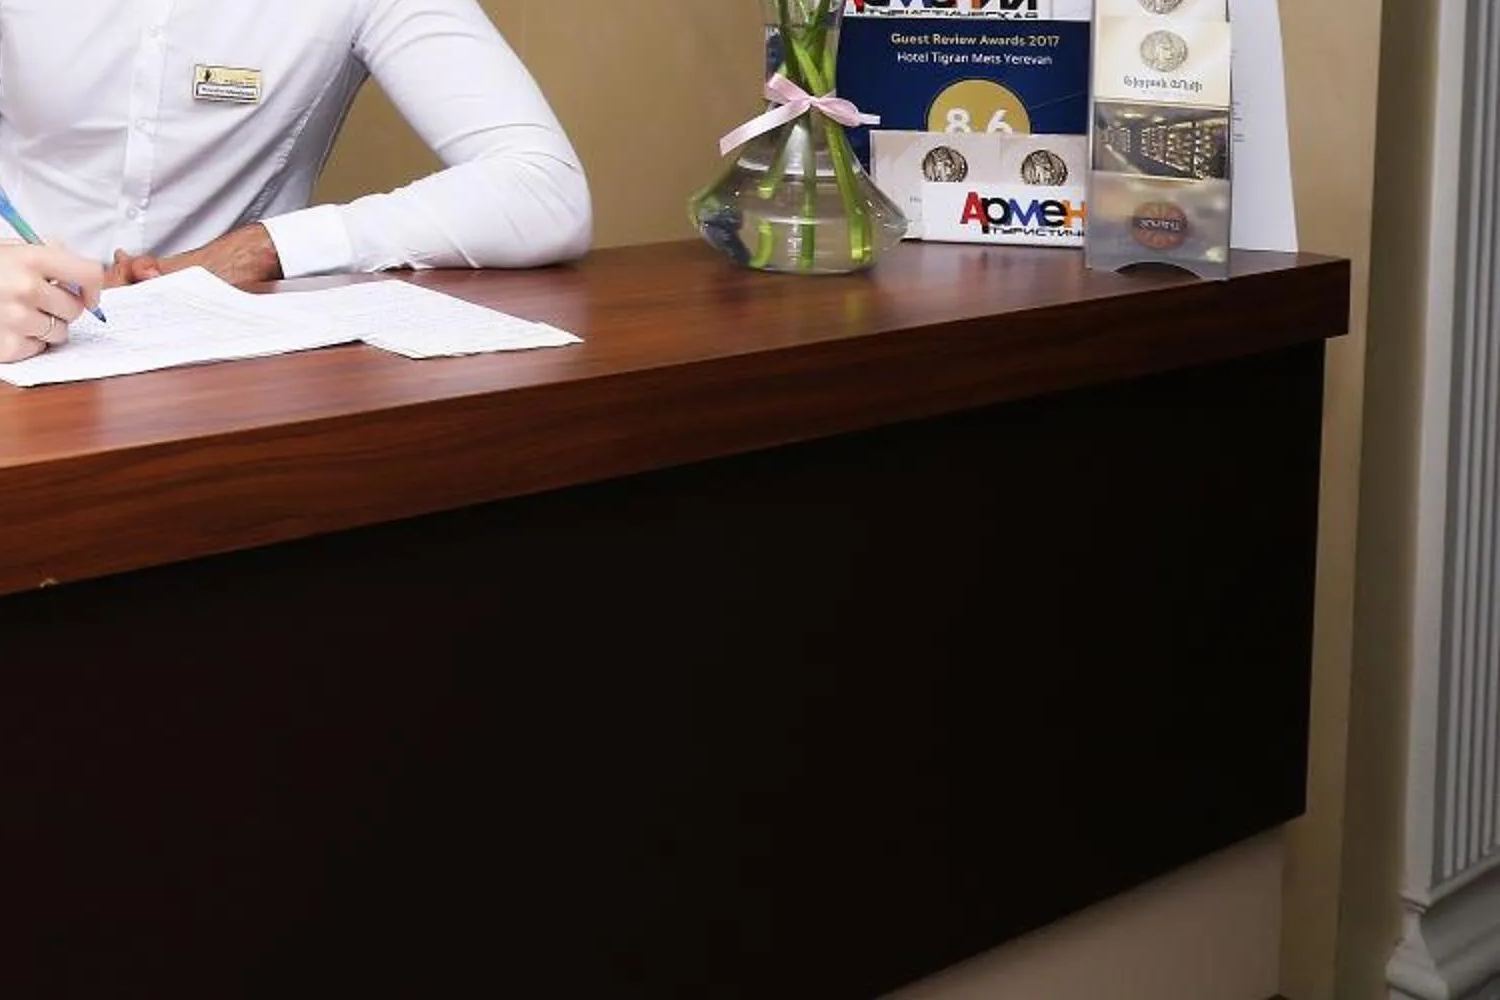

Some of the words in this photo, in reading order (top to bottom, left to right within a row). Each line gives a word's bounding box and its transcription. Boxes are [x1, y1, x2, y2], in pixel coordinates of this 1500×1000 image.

[891, 33, 930, 46] Guest
[933, 33, 978, 46] Review
[979, 34, 1025, 47] Awards
[1026, 35, 1061, 48] 2017
[897, 51, 929, 63] Hotel
[931, 51, 969, 66] Tigran
[971, 52, 1001, 65] Mets
[1003, 53, 1053, 66] Yerevan
